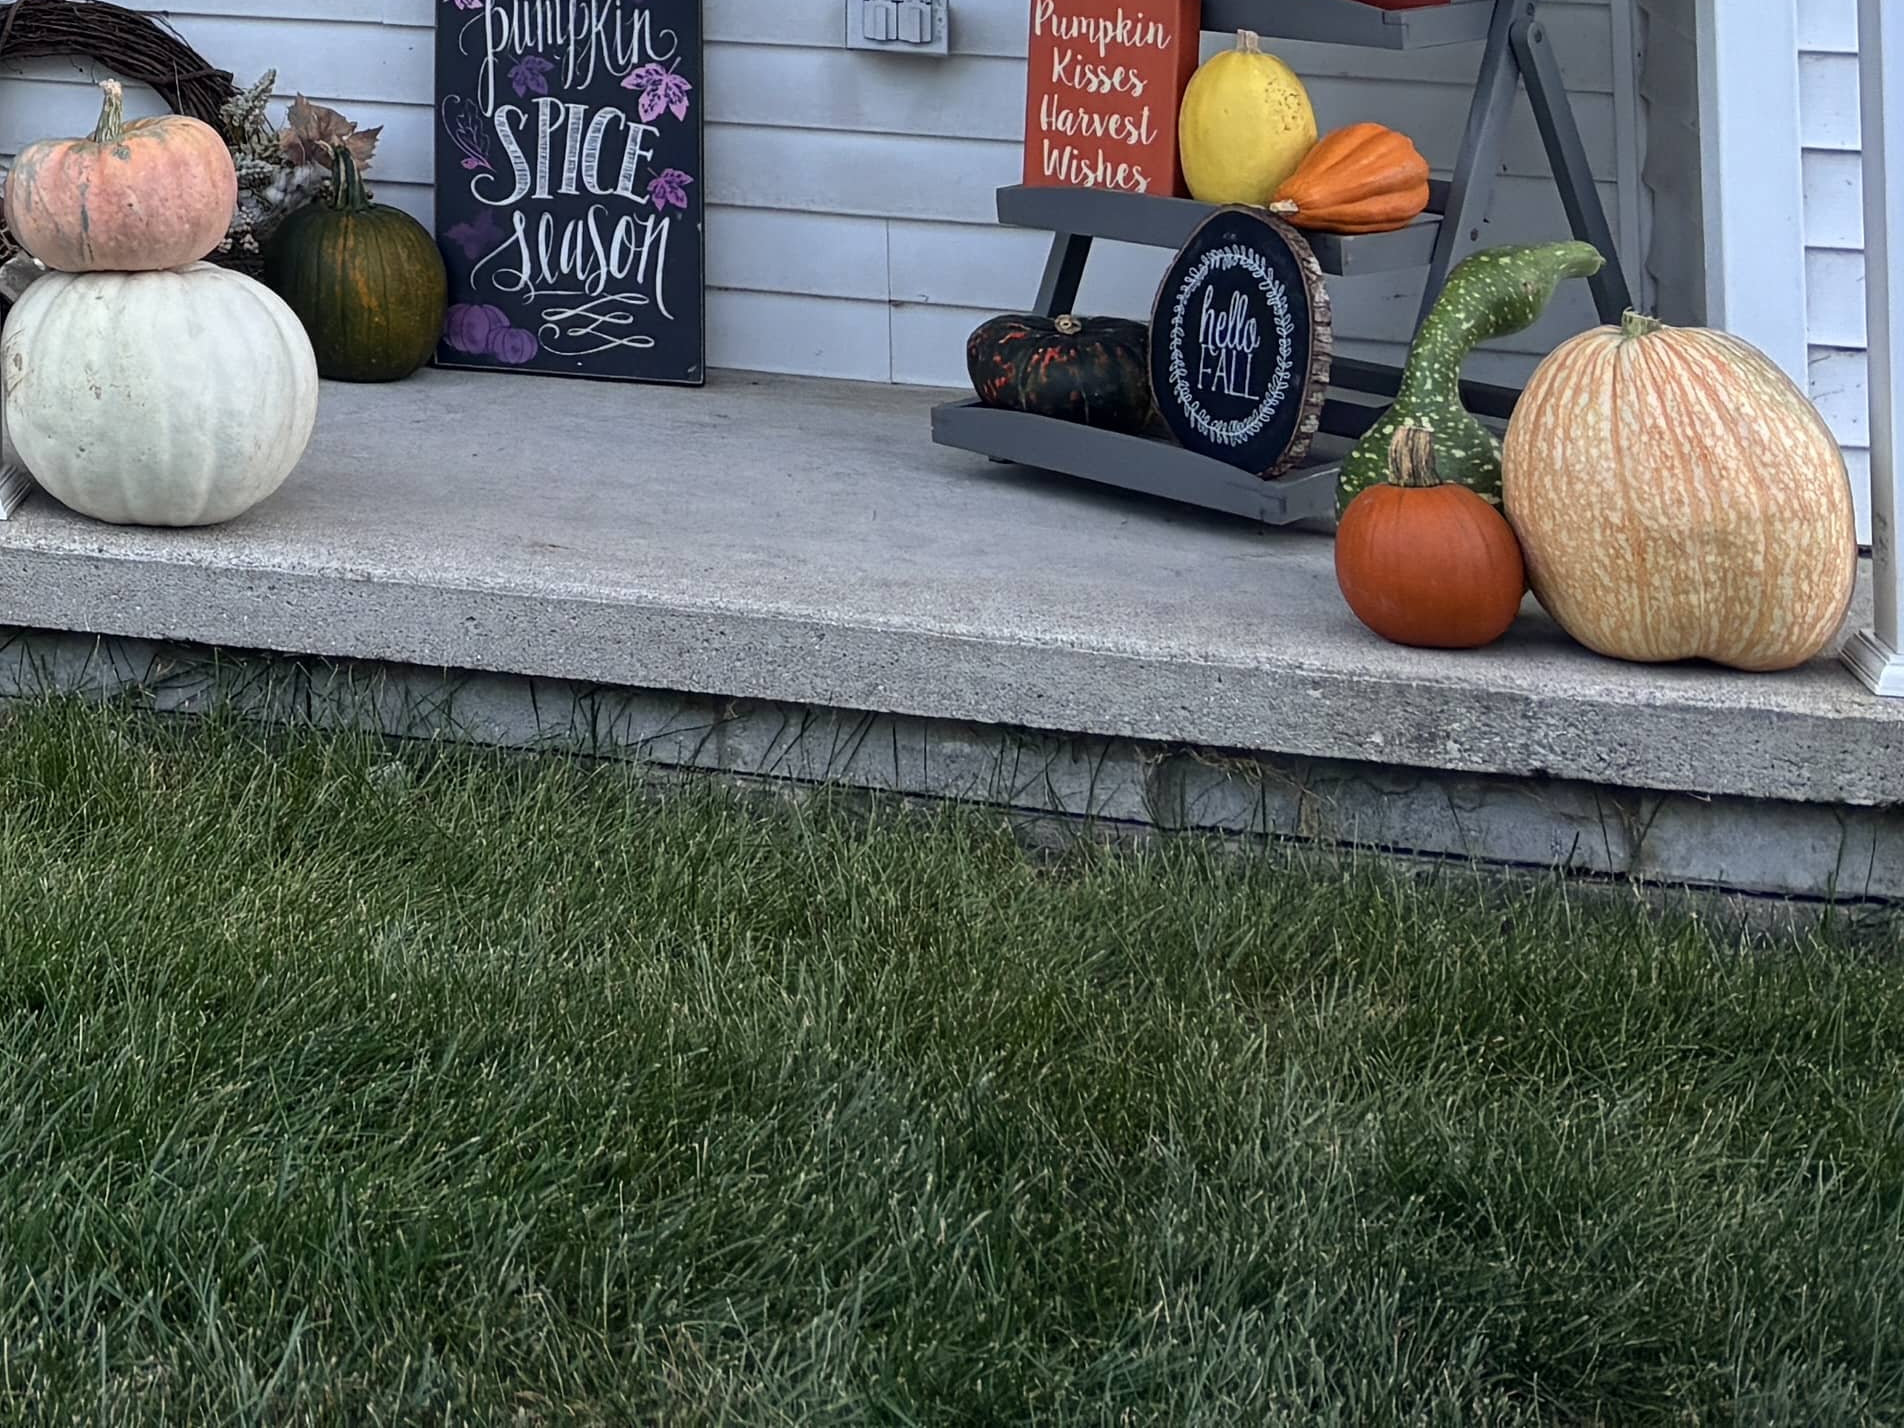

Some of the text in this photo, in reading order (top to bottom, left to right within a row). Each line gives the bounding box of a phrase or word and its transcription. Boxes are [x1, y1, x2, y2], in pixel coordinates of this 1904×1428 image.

[1051, 47, 1147, 98] Kisses
[1039, 93, 1158, 145] Harvest
[470, 97, 660, 207] SPICE
[1042, 138, 1152, 193] Wishes
[470, 204, 674, 321] season
[1199, 285, 1260, 355] hello
[1197, 343, 1260, 401] FALL
